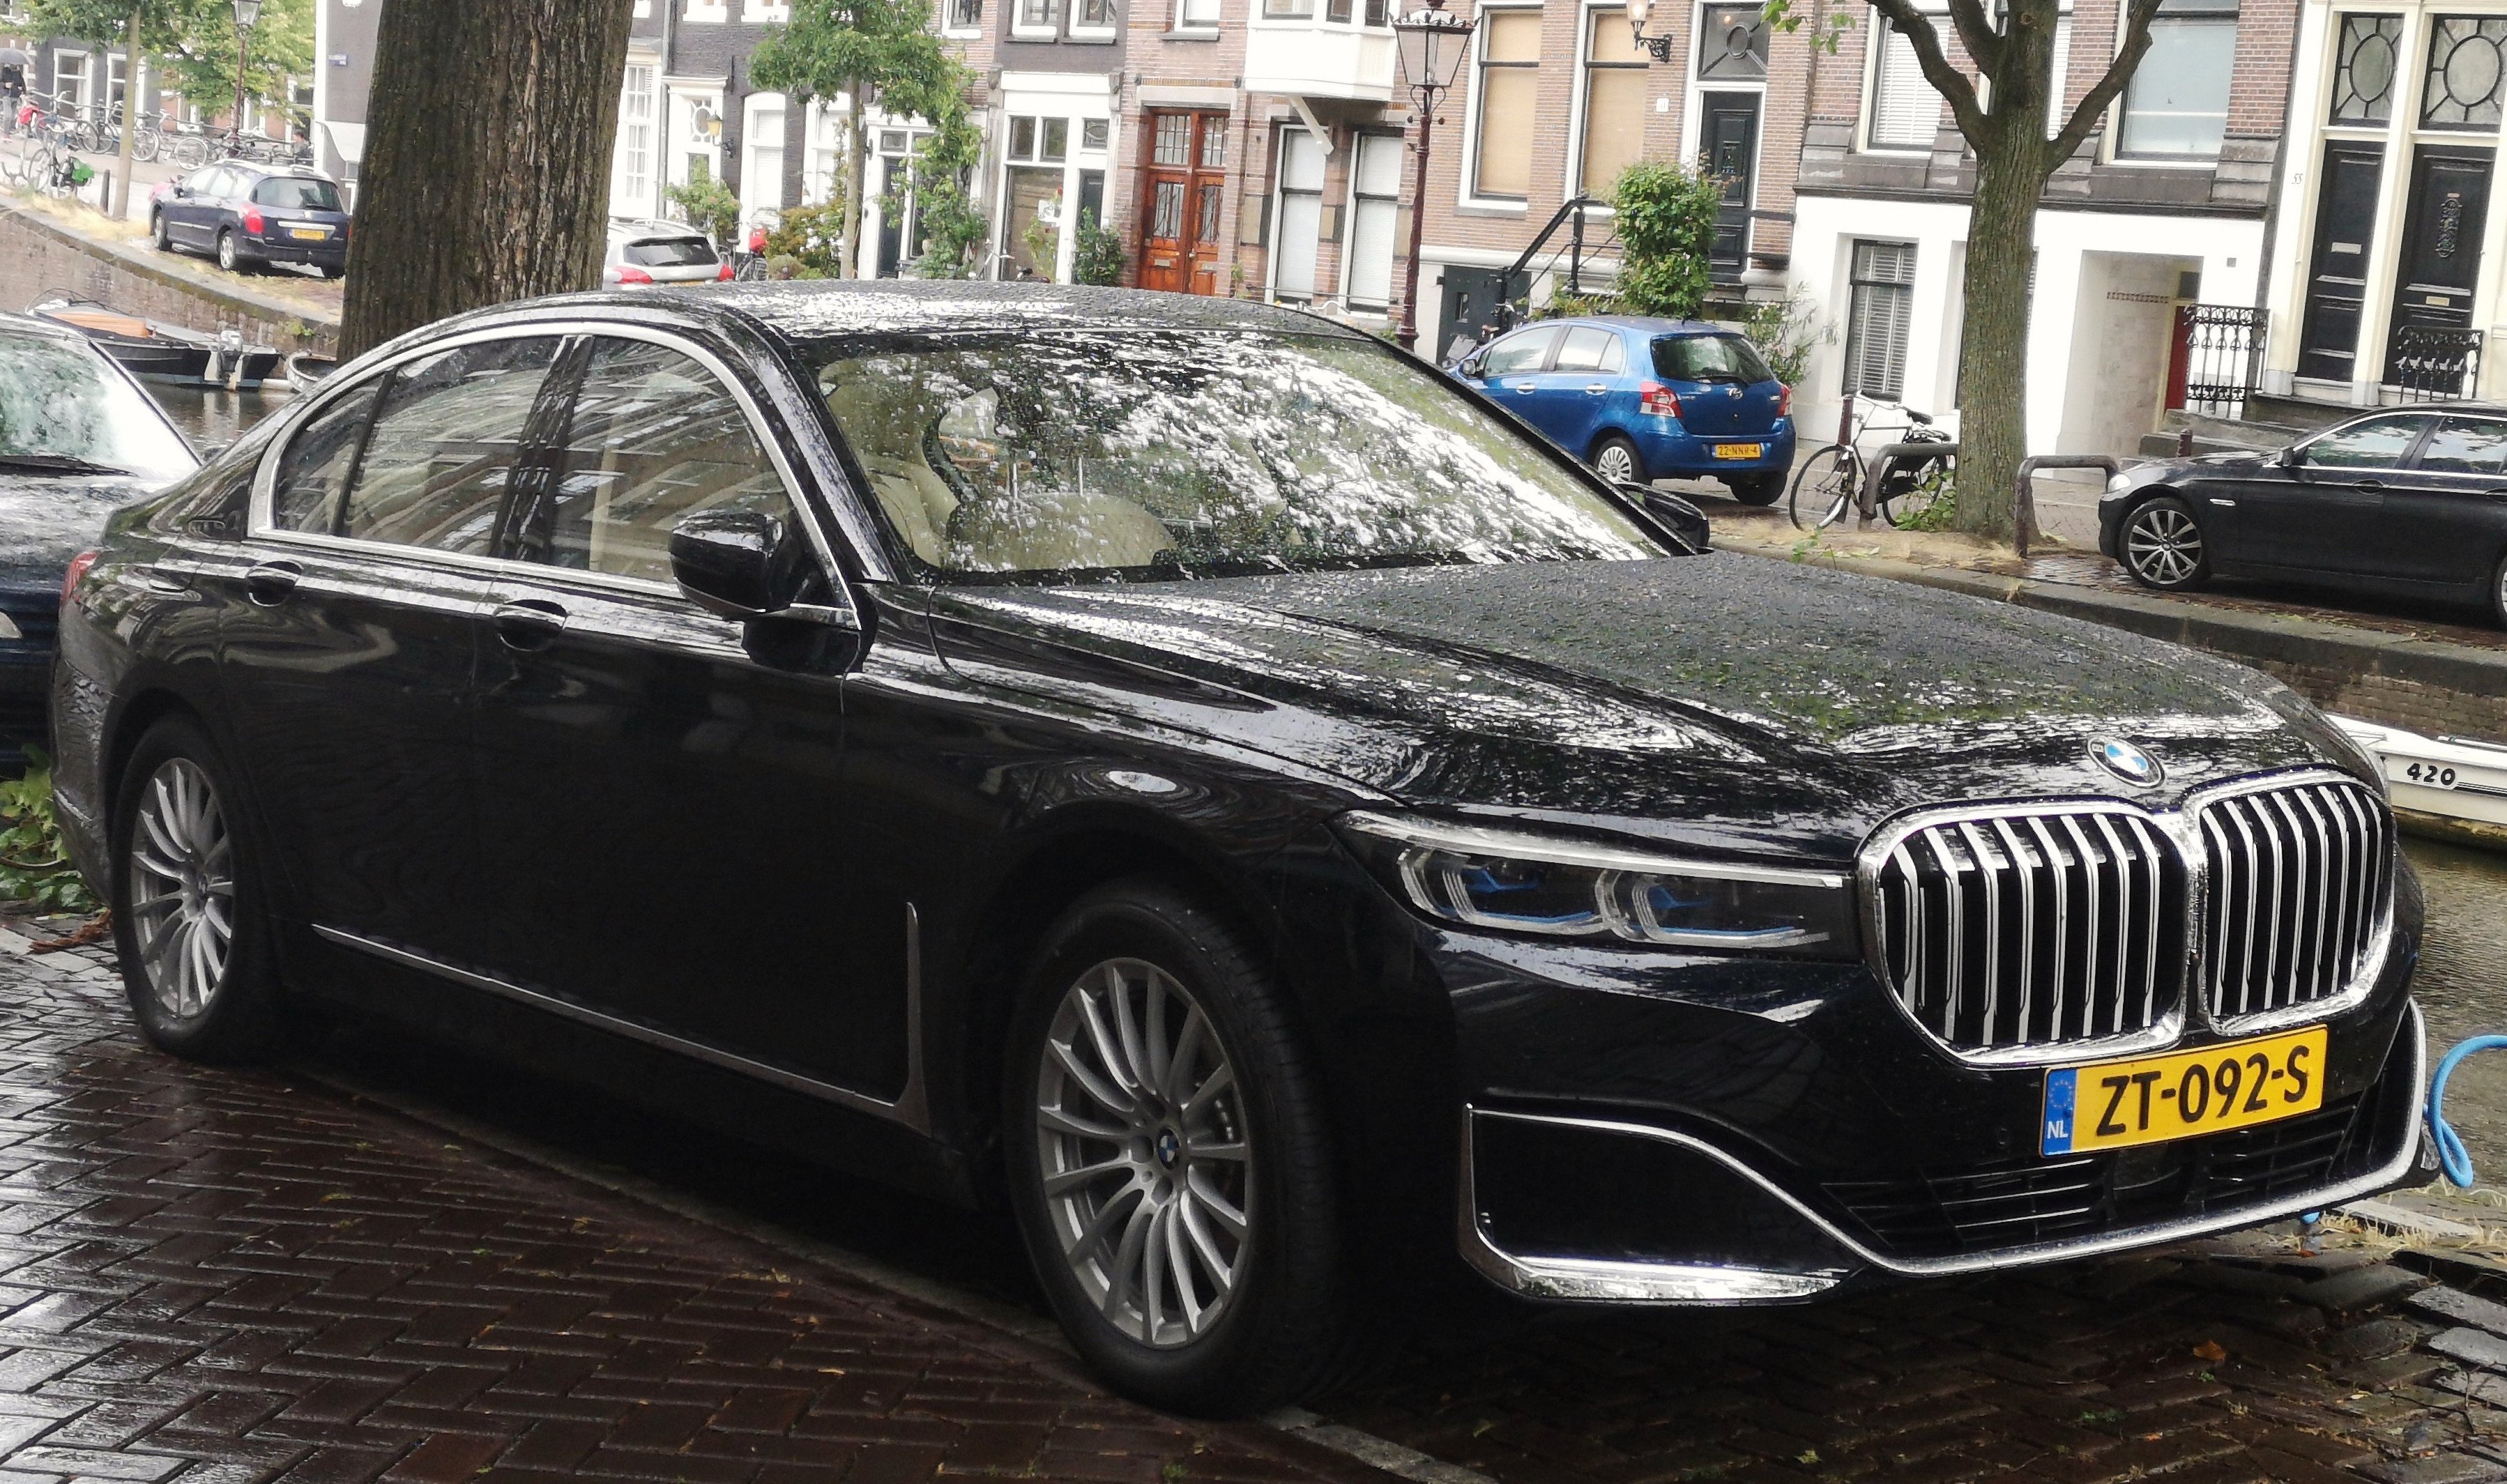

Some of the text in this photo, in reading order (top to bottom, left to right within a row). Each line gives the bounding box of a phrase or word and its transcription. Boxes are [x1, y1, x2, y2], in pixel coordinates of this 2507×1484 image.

[2407, 763, 2455, 786] 420
[2096, 1045, 2310, 1137] ZT-092-S
[2047, 1119, 2068, 1140] NL
